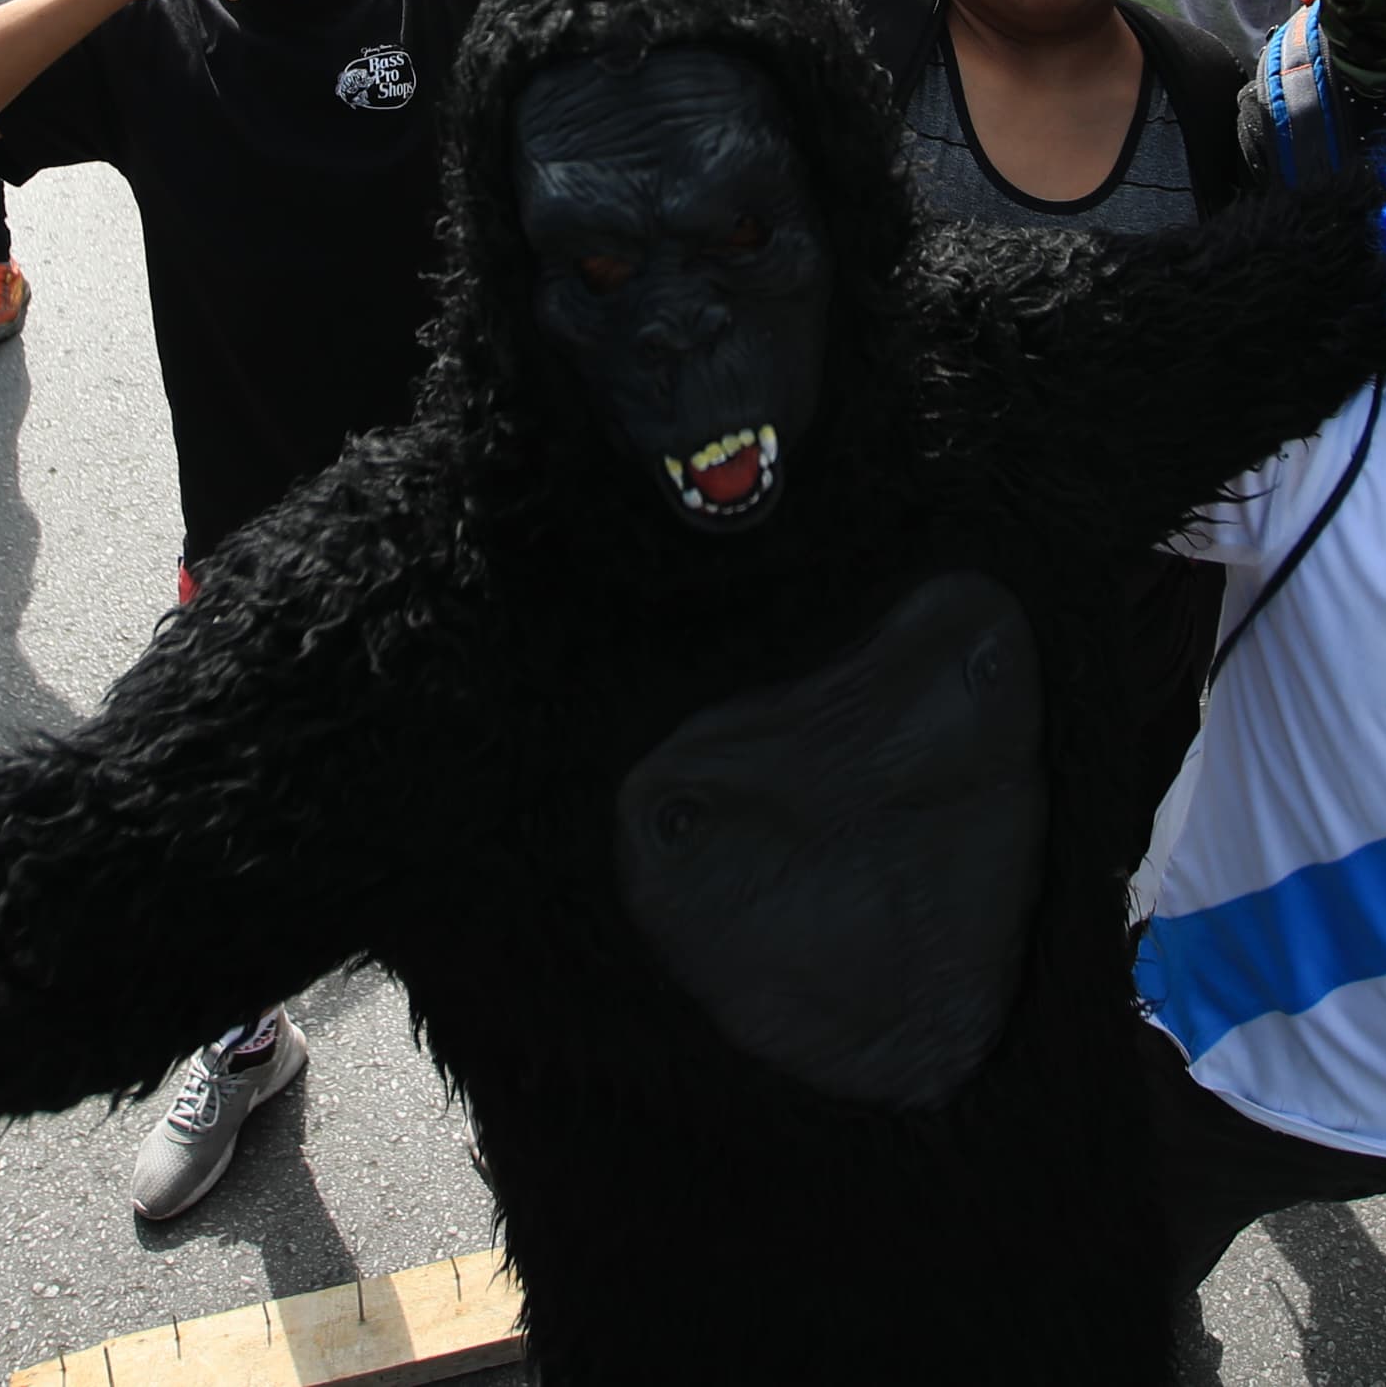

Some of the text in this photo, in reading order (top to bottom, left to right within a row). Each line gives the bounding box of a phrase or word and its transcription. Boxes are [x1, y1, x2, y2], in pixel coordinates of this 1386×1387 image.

[368, 53, 405, 73] Bass
[373, 69, 400, 85] Pro
[377, 81, 414, 100] Shops
